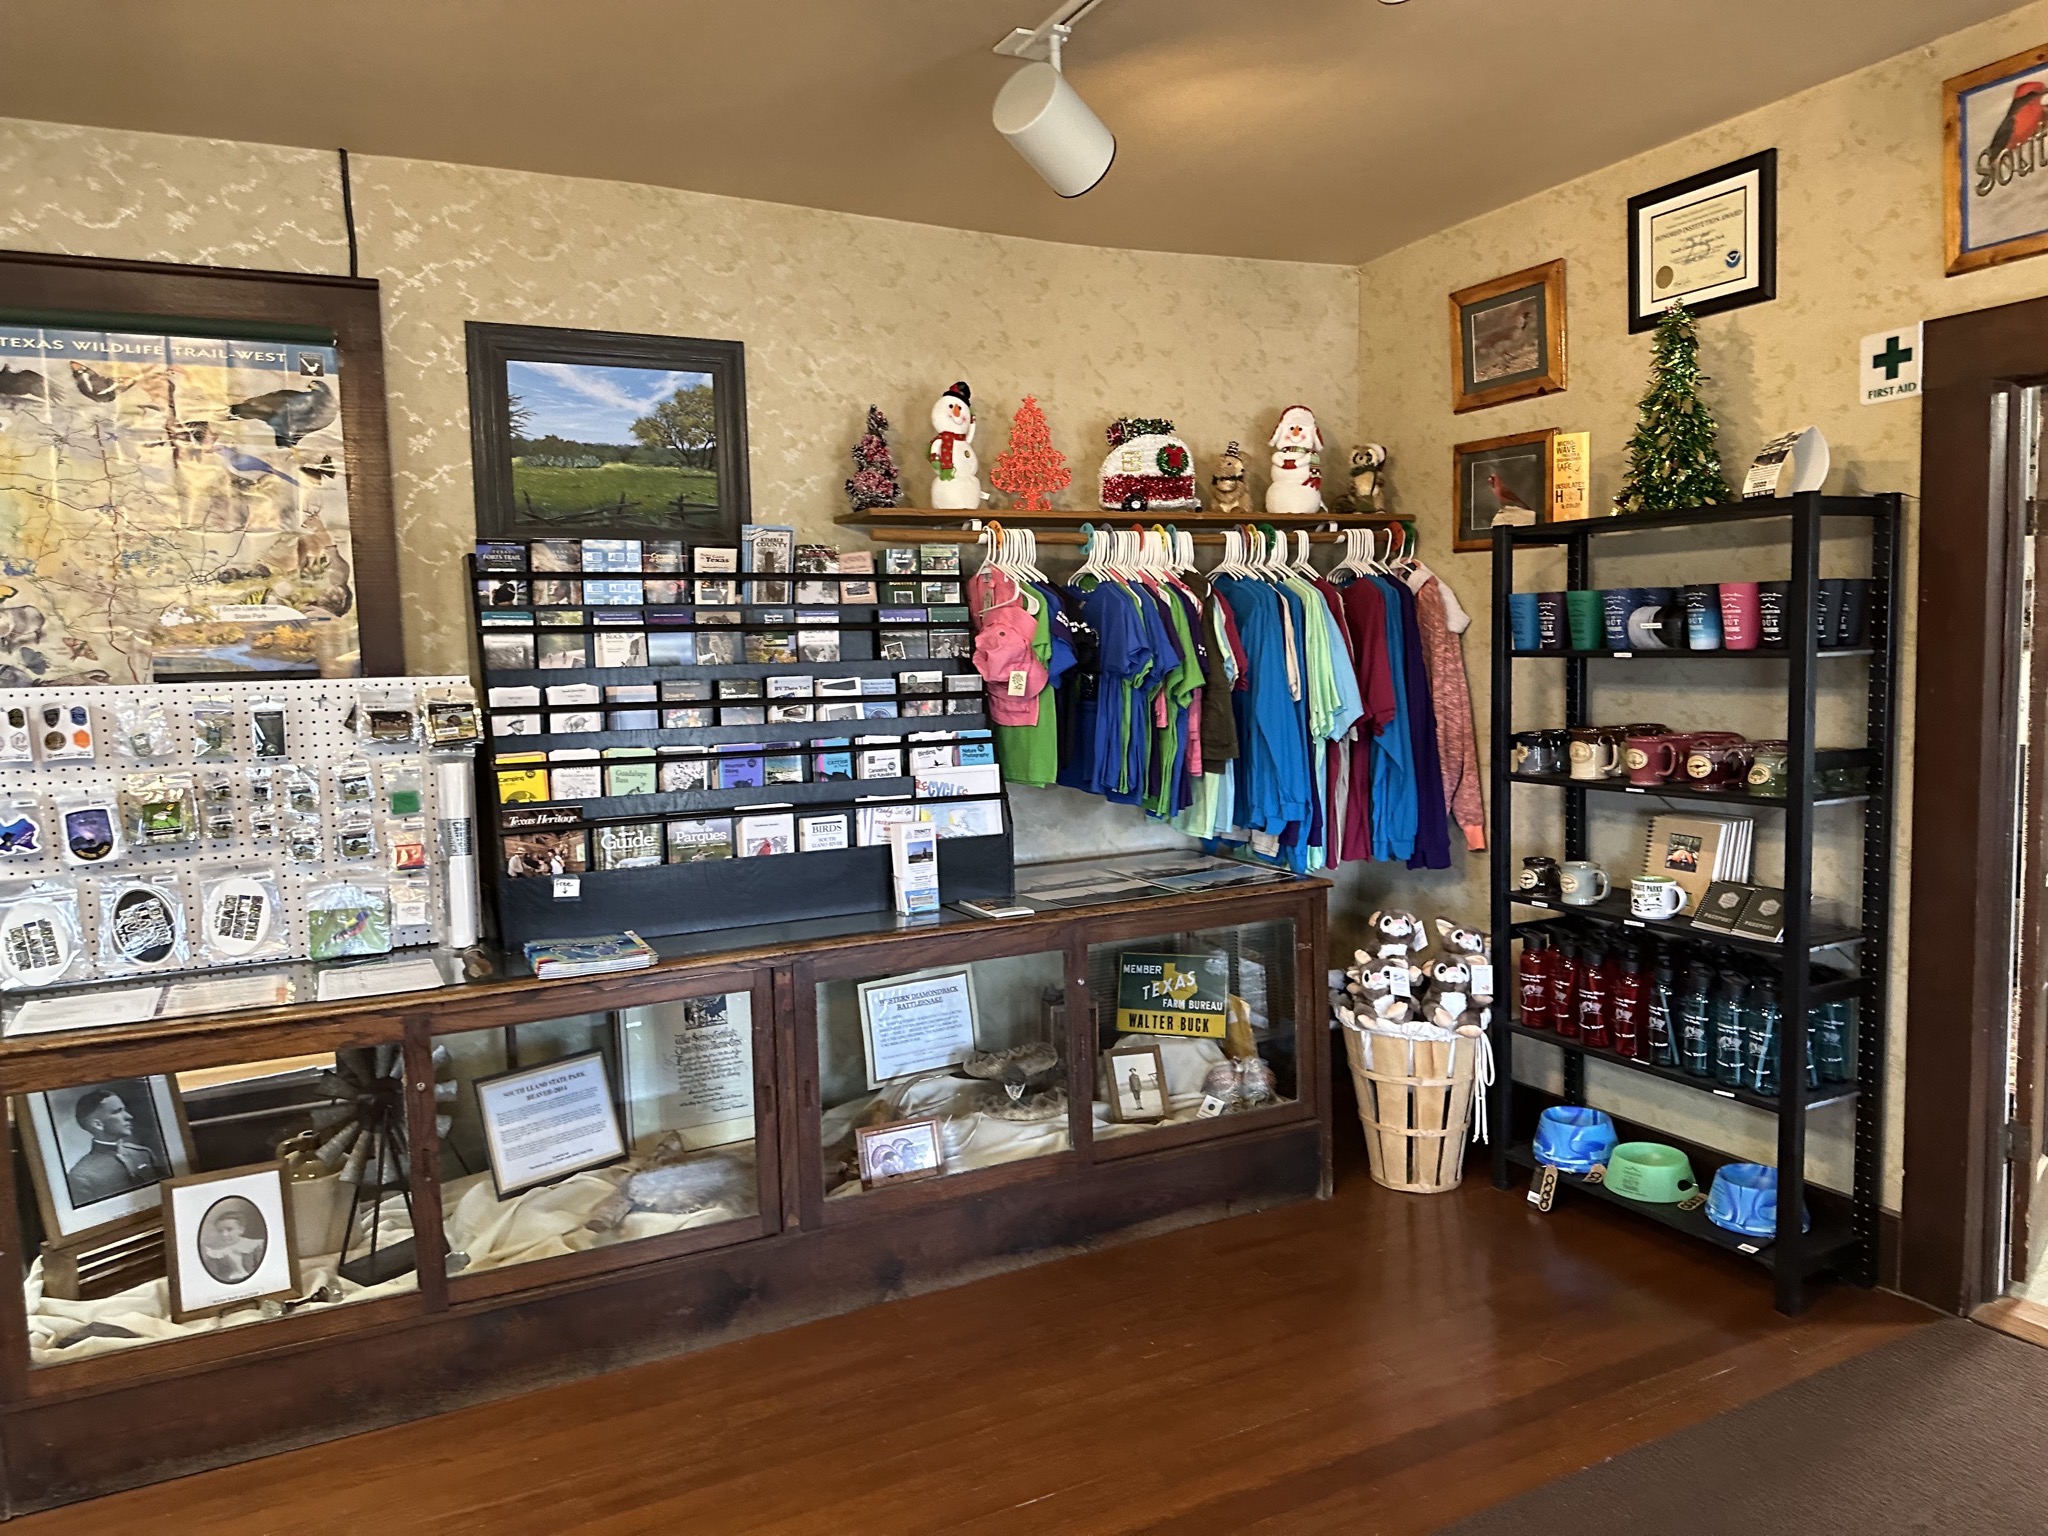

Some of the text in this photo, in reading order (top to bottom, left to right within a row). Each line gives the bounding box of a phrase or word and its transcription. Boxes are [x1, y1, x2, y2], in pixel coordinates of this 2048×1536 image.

[0, 337, 287, 363] TEXAS WILDLIFE TRAIL-WEST
[1868, 382, 1917, 399] FIRST AID
[1556, 446, 1576, 454] WAVE
[1557, 462, 1572, 472] SAFE
[918, 749, 936, 757] Birding
[875, 807, 893, 818] Ready
[509, 814, 578, 827] Texas Heritage
[812, 824, 842, 834] BIRDS
[601, 831, 656, 850] Guide
[675, 829, 727, 844] Parques
[555, 880, 573, 888] Free
[1633, 884, 1646, 892] STATE
[218, 895, 237, 936] RIVER
[232, 895, 250, 939] LLANO
[244, 896, 263, 941] SOUTH
[1703, 912, 1734, 923] PASSPORT
[1744, 920, 1775, 931] PASSPORT
[9, 927, 31, 971] RIVER
[23, 922, 46, 968] LLANO
[1123, 964, 1162, 975] MEMBER
[1142, 971, 1196, 1000] TEXAS
[911, 986, 959, 1000] DIAMONDBACK
[896, 996, 943, 1011] RATTLESNAKE
[1162, 998, 1223, 1011] FARM BUREAU
[1129, 1013, 1210, 1033] WALTER BUCK
[503, 1071, 586, 1097] SOUTH LLANO STATE PARK
